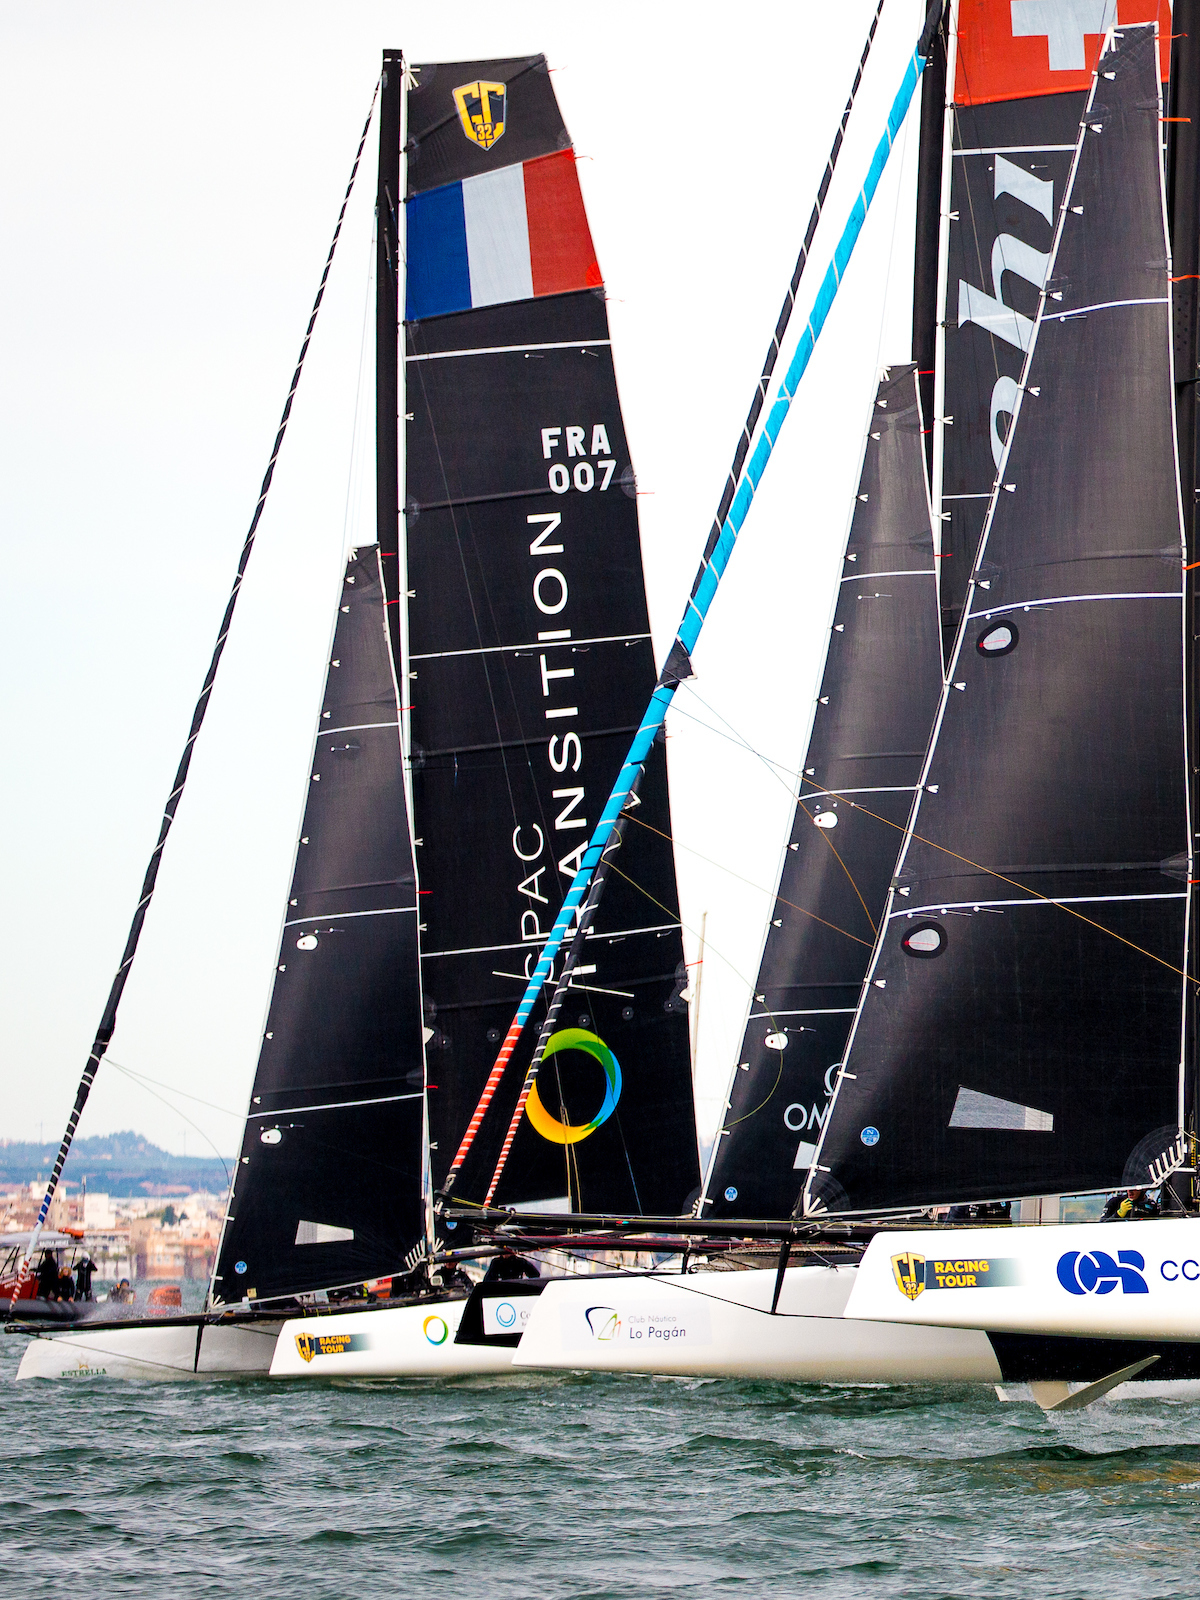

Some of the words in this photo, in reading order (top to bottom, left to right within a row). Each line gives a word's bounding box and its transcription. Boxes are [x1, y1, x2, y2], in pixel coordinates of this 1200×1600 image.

[541, 424, 611, 459] FRA
[548, 460, 617, 494] 007
[934, 1260, 990, 1274] RACING
[936, 1275, 977, 1287] TOUR
[628, 1315, 645, 1324] Club
[648, 1313, 677, 1323] Náutico
[319, 1335, 351, 1345] RACING
[630, 1327, 642, 1339] Lo
[648, 1326, 686, 1341] Pagán
[320, 1344, 344, 1353] TOUR
